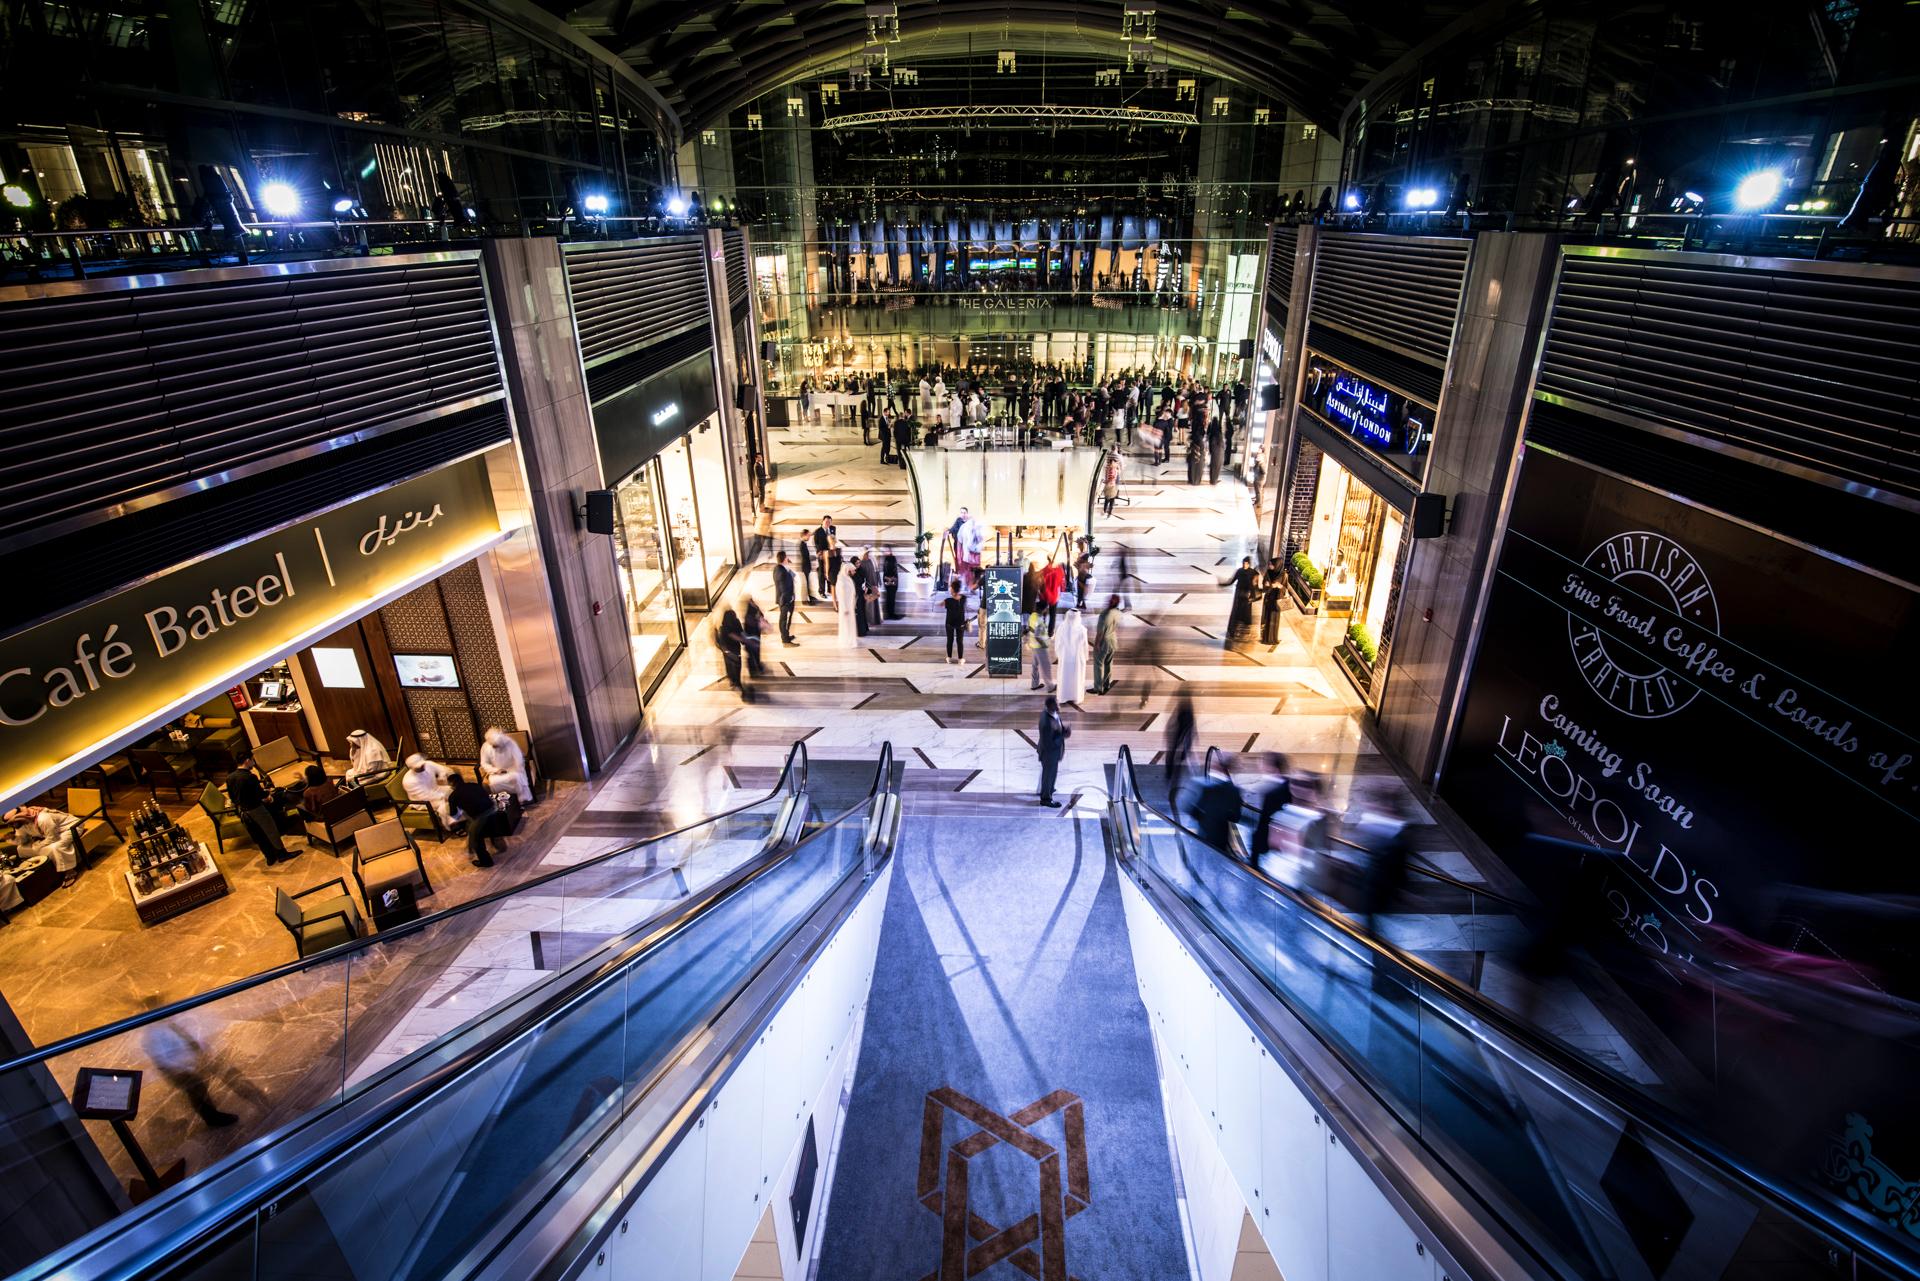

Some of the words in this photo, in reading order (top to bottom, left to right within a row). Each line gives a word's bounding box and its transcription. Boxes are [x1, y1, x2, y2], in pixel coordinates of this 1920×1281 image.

[957, 298, 980, 309] THE
[983, 298, 1052, 309] GALLERIA
[1352, 410, 1361, 435] of
[1359, 416, 1391, 443] LONDON
[359, 503, 445, 556] بتيل
[1605, 535, 1711, 610] ARTISAN
[0, 624, 137, 727] Café
[145, 552, 295, 658] Bateel
[1562, 573, 1602, 610] Fine
[1603, 595, 1657, 645] Food,
[1663, 626, 1737, 684] Coffee
[1739, 673, 1766, 700] &
[1768, 688, 1859, 753] Loads
[1868, 751, 1913, 786] of
[1573, 627, 1677, 714] CRAFTED
[1539, 693, 1623, 778] Coming
[1628, 762, 1698, 830] Soon
[1497, 714, 1719, 924] LEOPOLD'S
[1568, 816, 1578, 828] Of
[1578, 824, 1601, 849] London
